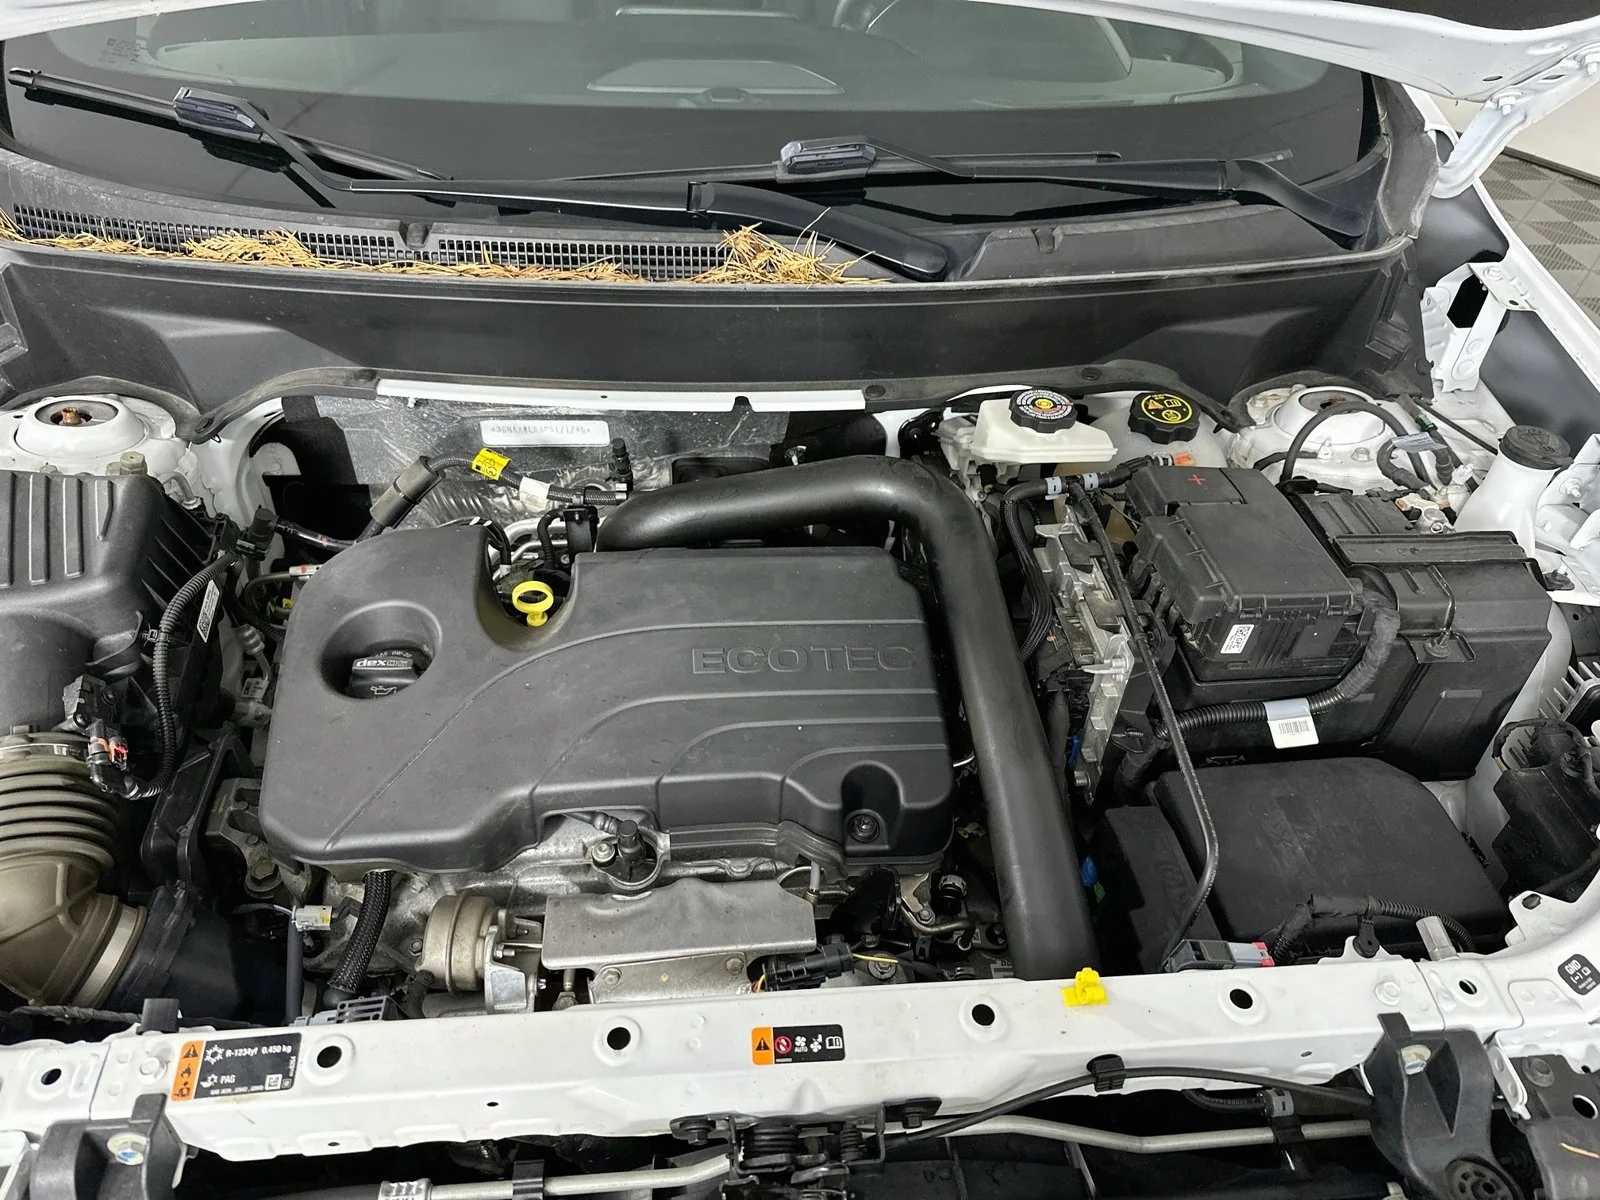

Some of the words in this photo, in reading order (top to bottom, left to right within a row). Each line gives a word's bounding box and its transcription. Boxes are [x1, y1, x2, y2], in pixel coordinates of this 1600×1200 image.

[691, 645, 915, 675] ECOTEC
[1564, 959, 1582, 975] GND
[225, 1047, 258, 1057] R-1234yf
[261, 1046, 282, 1054] 0.450
[282, 1045, 292, 1054] kg
[220, 1074, 236, 1084] PAG
